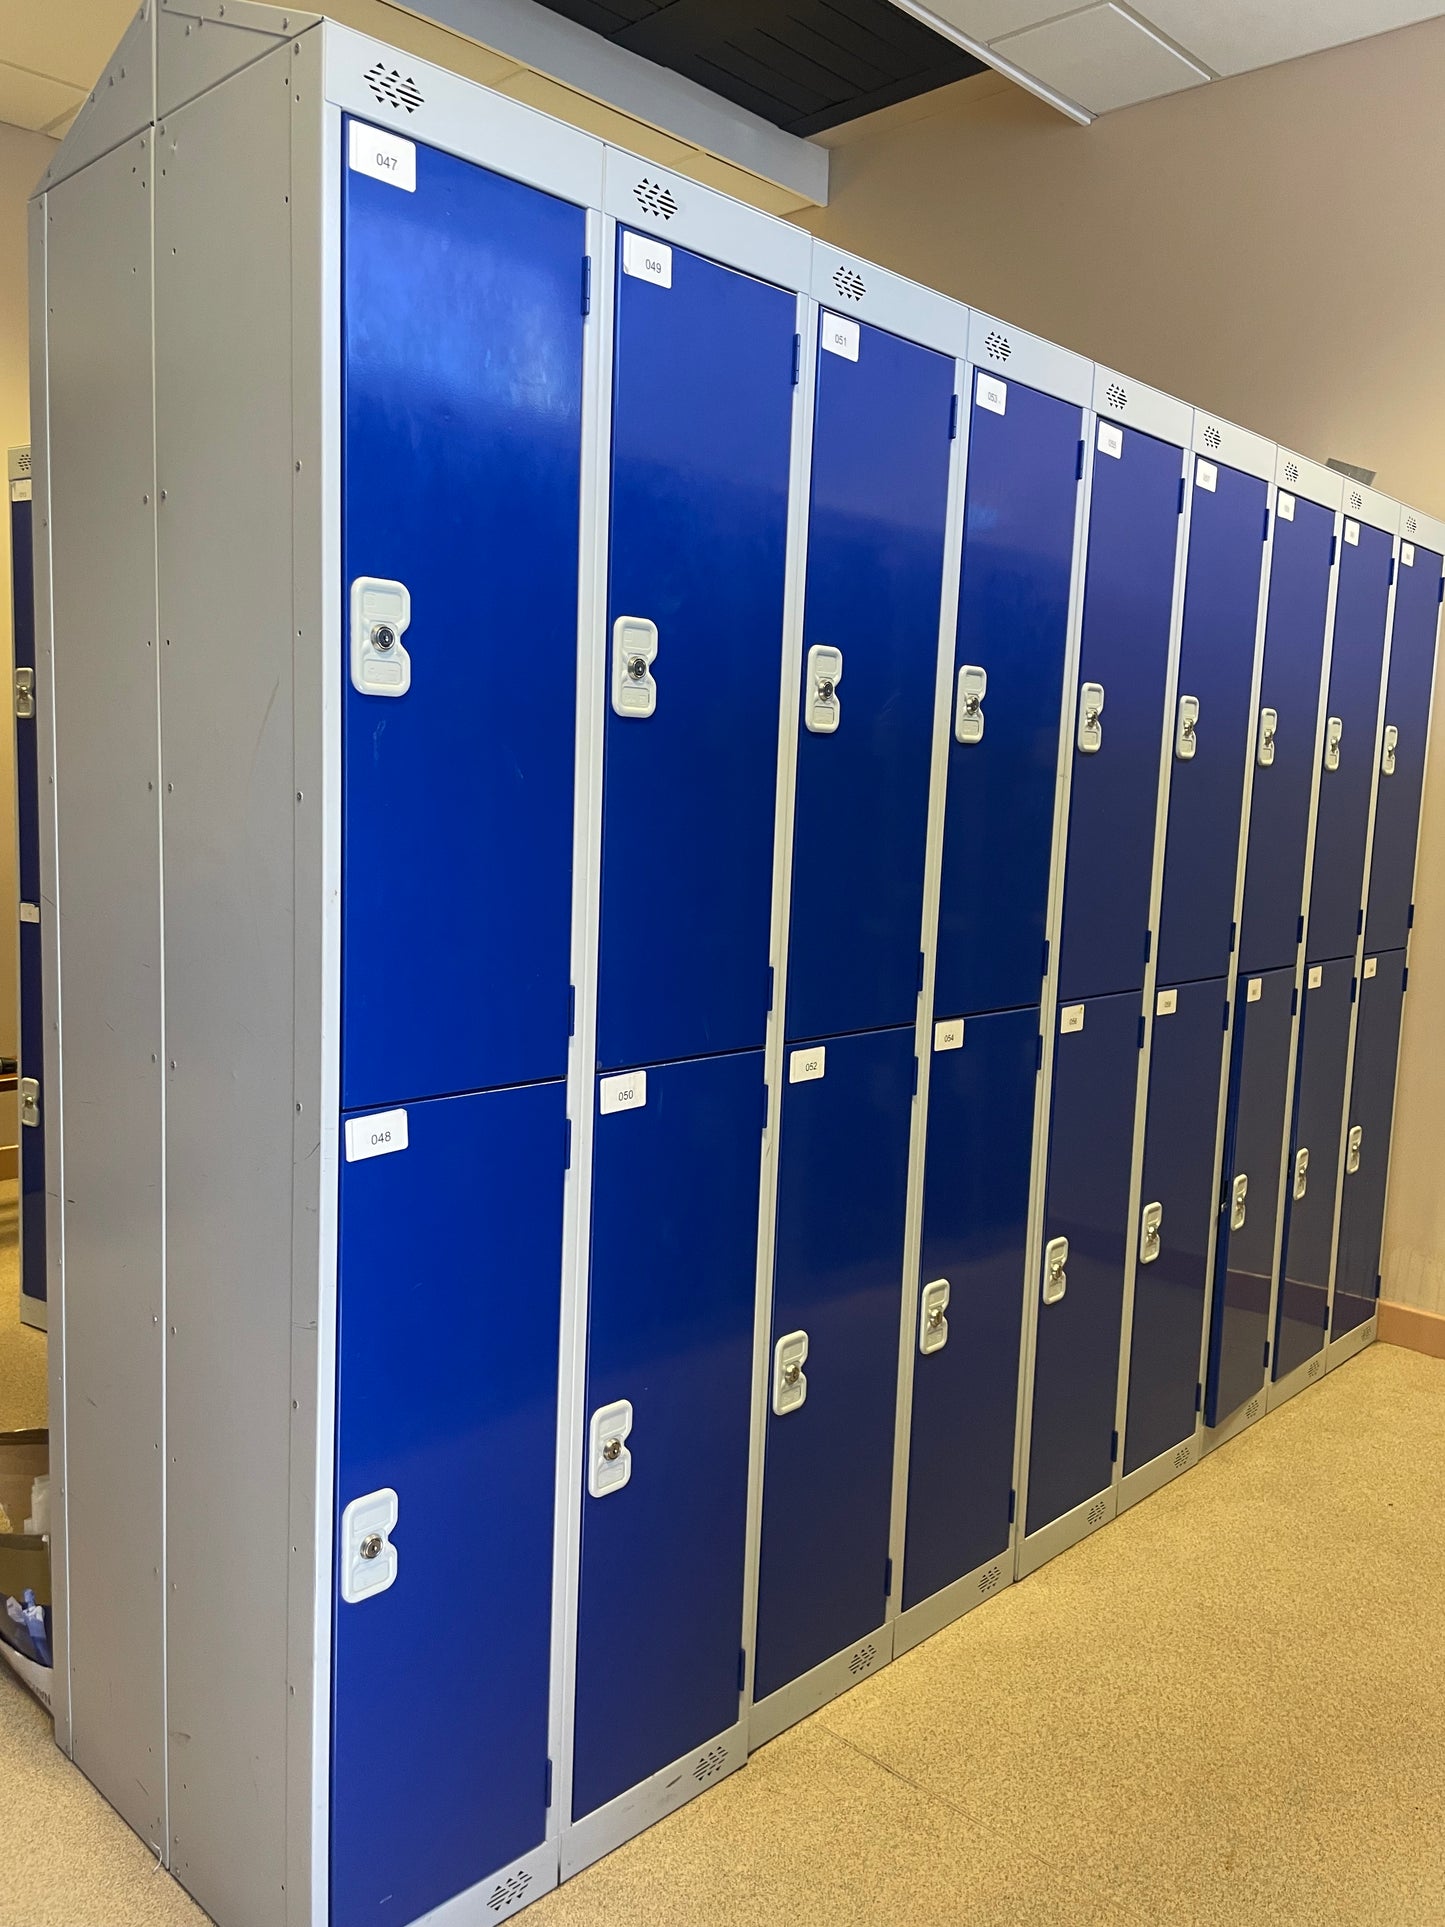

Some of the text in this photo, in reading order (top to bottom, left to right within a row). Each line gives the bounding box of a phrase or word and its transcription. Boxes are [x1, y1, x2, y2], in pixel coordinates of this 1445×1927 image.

[376, 152, 398, 171] 047
[645, 258, 662, 274] 049
[834, 333, 847, 347] 051
[805, 1061, 818, 1072] 052
[618, 1089, 634, 1102] 050
[371, 1130, 392, 1146] 048
